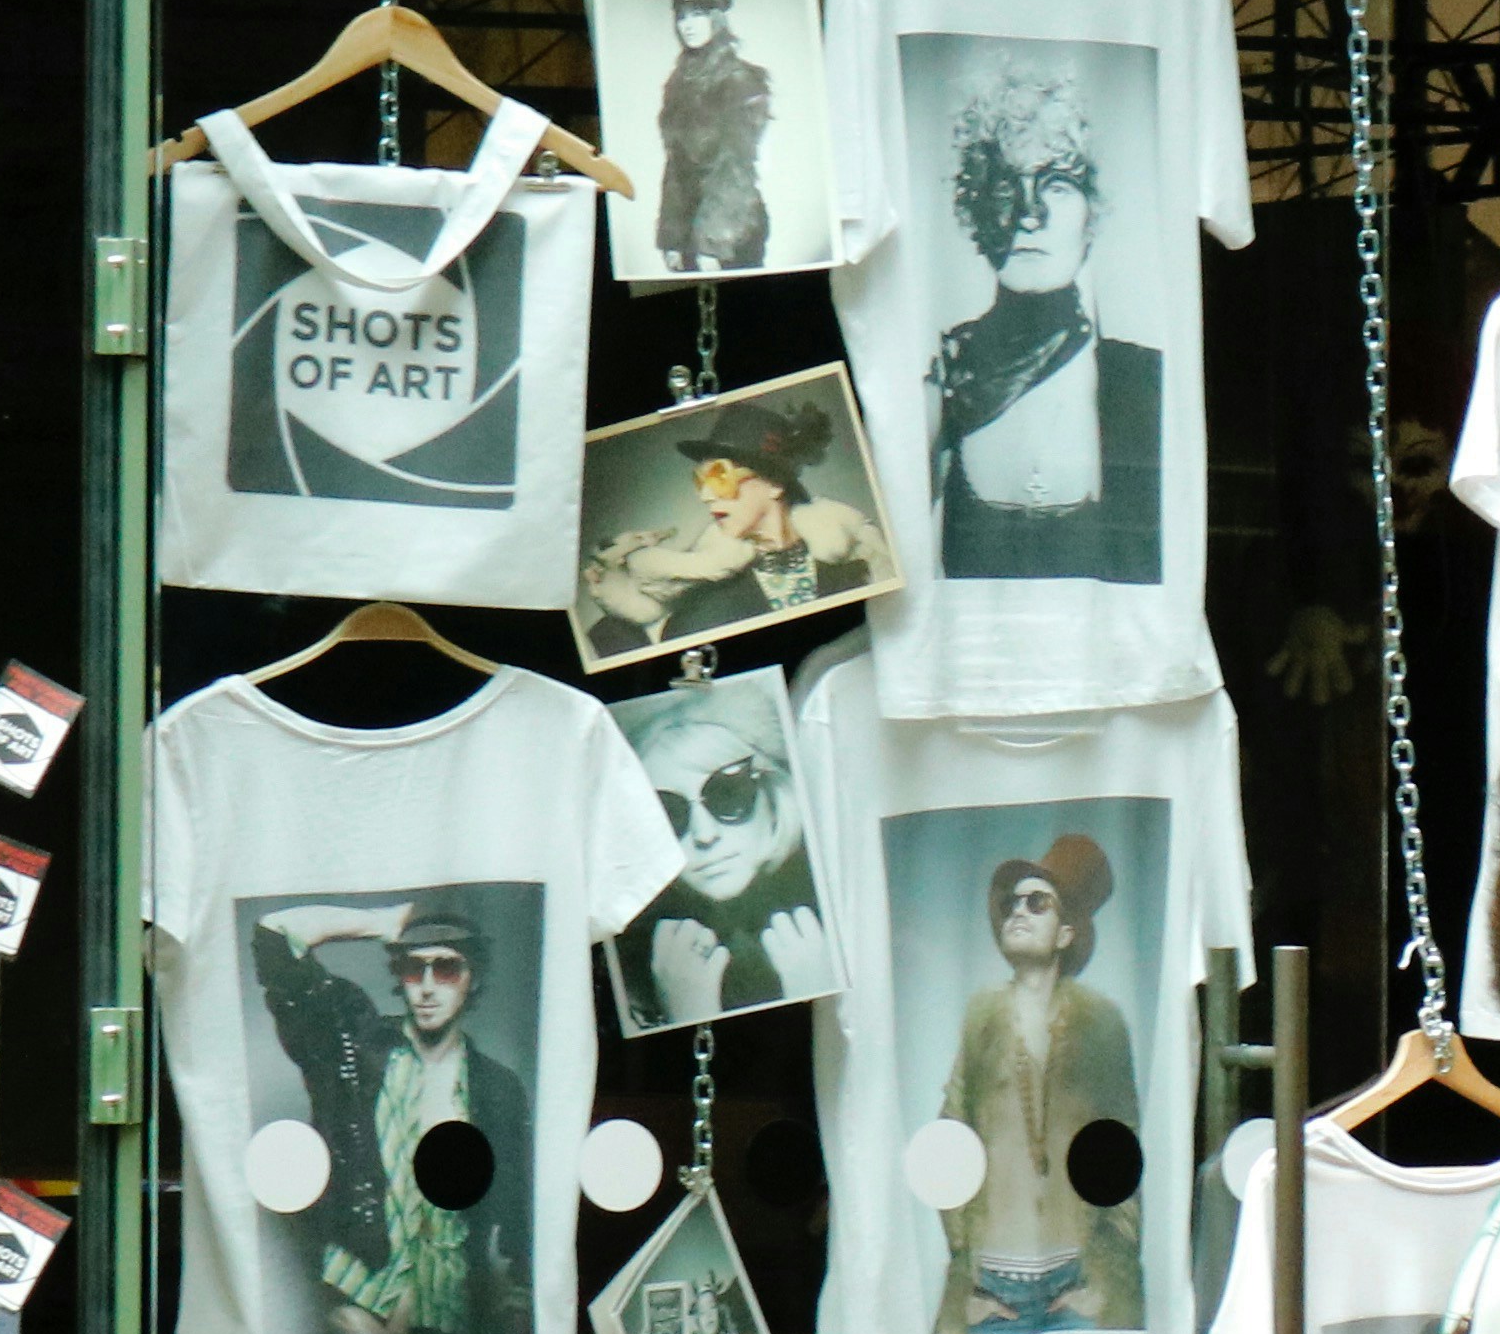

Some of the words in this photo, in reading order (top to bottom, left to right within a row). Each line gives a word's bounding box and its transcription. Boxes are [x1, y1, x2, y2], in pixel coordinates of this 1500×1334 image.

[292, 302, 462, 353] SHOTS
[289, 354, 353, 391] OF
[365, 361, 462, 400] ART
[5, 740, 35, 760] ART
